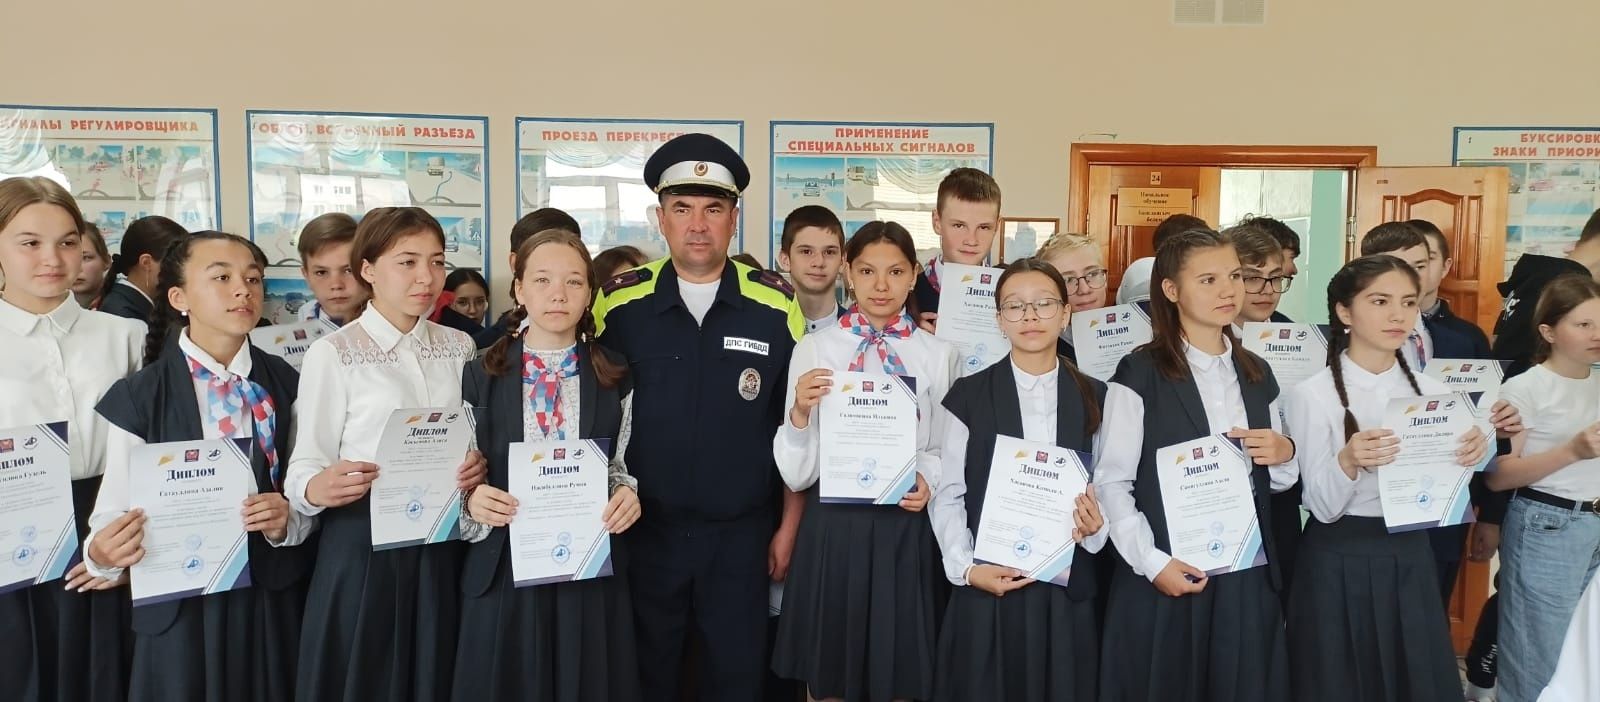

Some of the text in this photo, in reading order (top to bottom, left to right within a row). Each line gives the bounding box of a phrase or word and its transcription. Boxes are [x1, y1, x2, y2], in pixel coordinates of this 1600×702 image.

[2, 119, 199, 133] ГНАЛЫ РЕГУЛИРОВЩИКА
[414, 127, 475, 139] РАЗЪЕЗД
[542, 130, 685, 142] ПРОЕЗД ПЕРЕКРЕС
[835, 128, 929, 139] ПРИМЕНЕНИЕ
[788, 140, 975, 153] СПЕЦИАЛЬНЫХ СИГНАЛОВ
[1493, 146, 1537, 156] ЗНАКИ
[966, 286, 996, 298] Дипло
[1096, 325, 1129, 339] Диплом
[284, 344, 310, 356] Дип
[725, 338, 768, 352] ДПС ГИБДД
[1264, 343, 1302, 353] Диплом
[1443, 375, 1478, 384] Диплом
[848, 396, 888, 407] Диплом
[1409, 415, 1449, 428] Диплом
[407, 427, 448, 437] Диплом
[0, 456, 34, 470] плом
[166, 467, 216, 482] Диплом
[538, 465, 580, 477] Диплом
[1019, 463, 1059, 480] Диплом
[1183, 462, 1220, 478] Диплом
